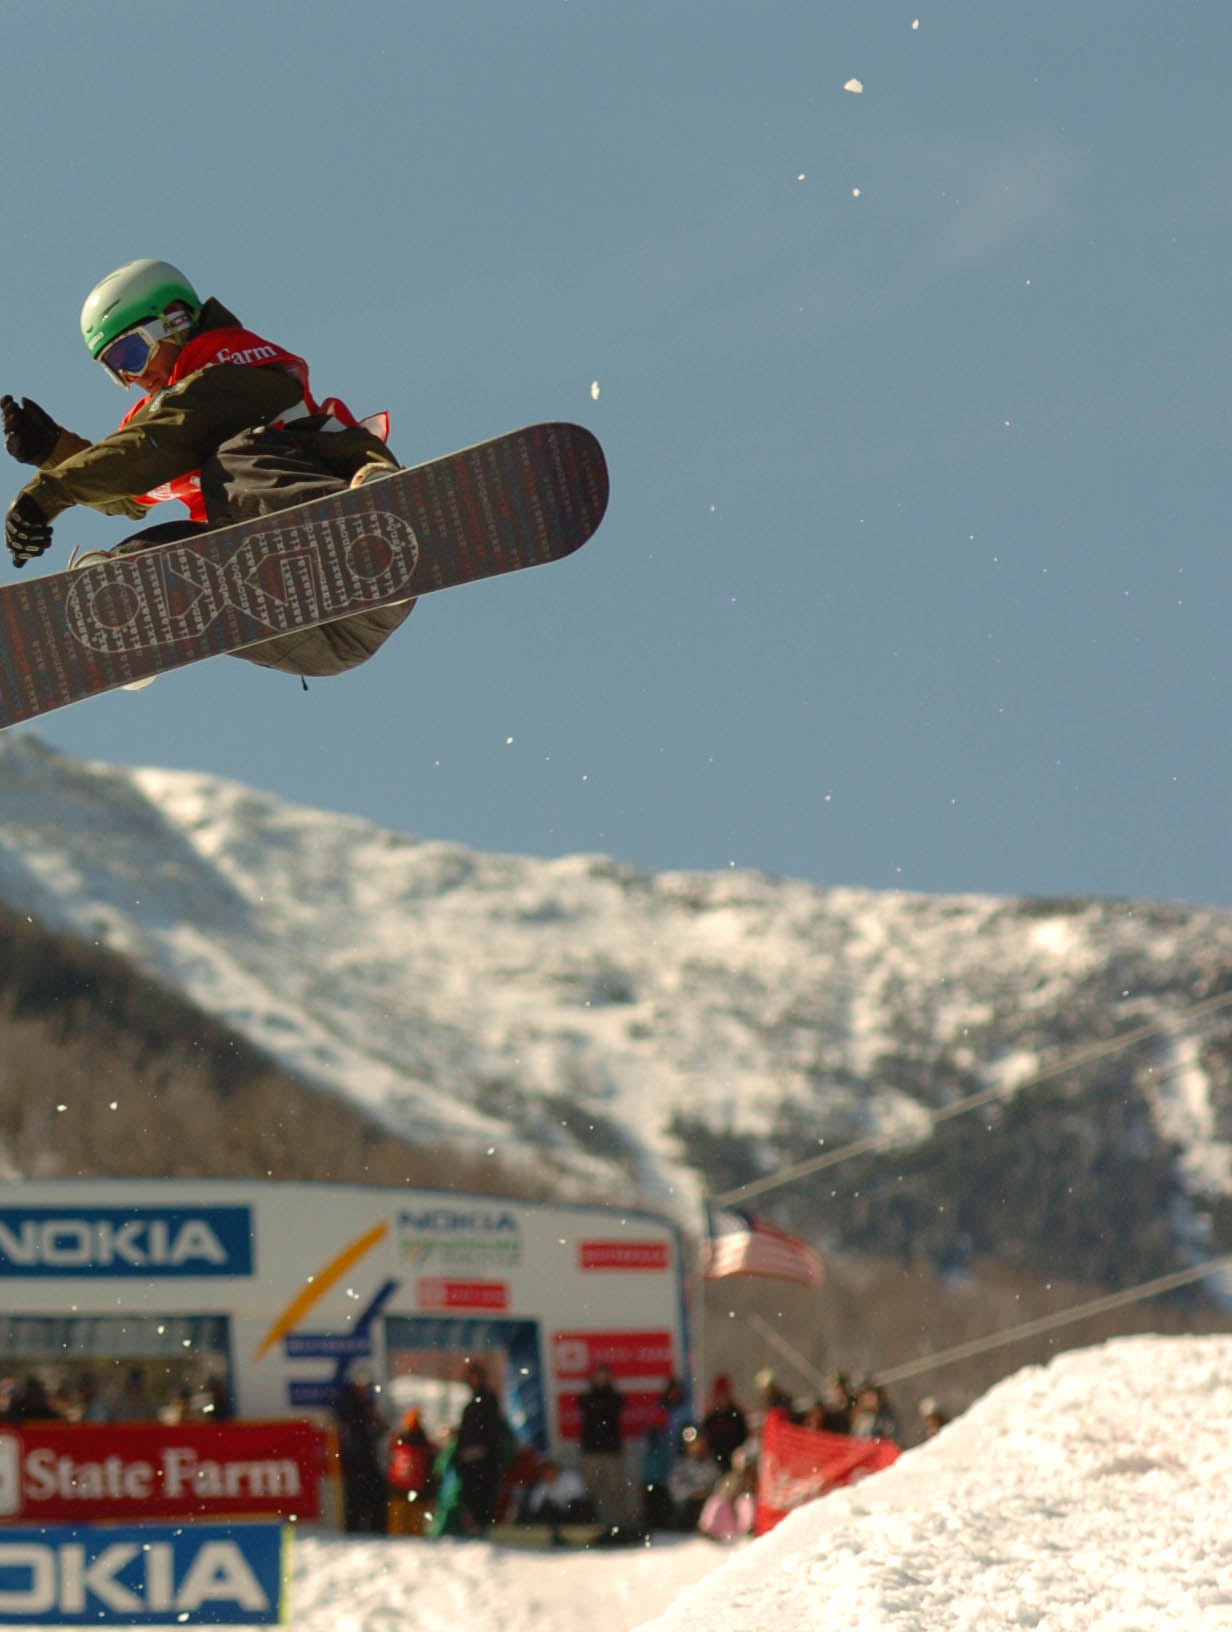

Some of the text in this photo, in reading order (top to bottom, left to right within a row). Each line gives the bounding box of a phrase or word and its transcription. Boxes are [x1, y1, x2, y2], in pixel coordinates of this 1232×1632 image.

[216, 345, 278, 365] Farm
[24, 1448, 301, 1500] State Farm
